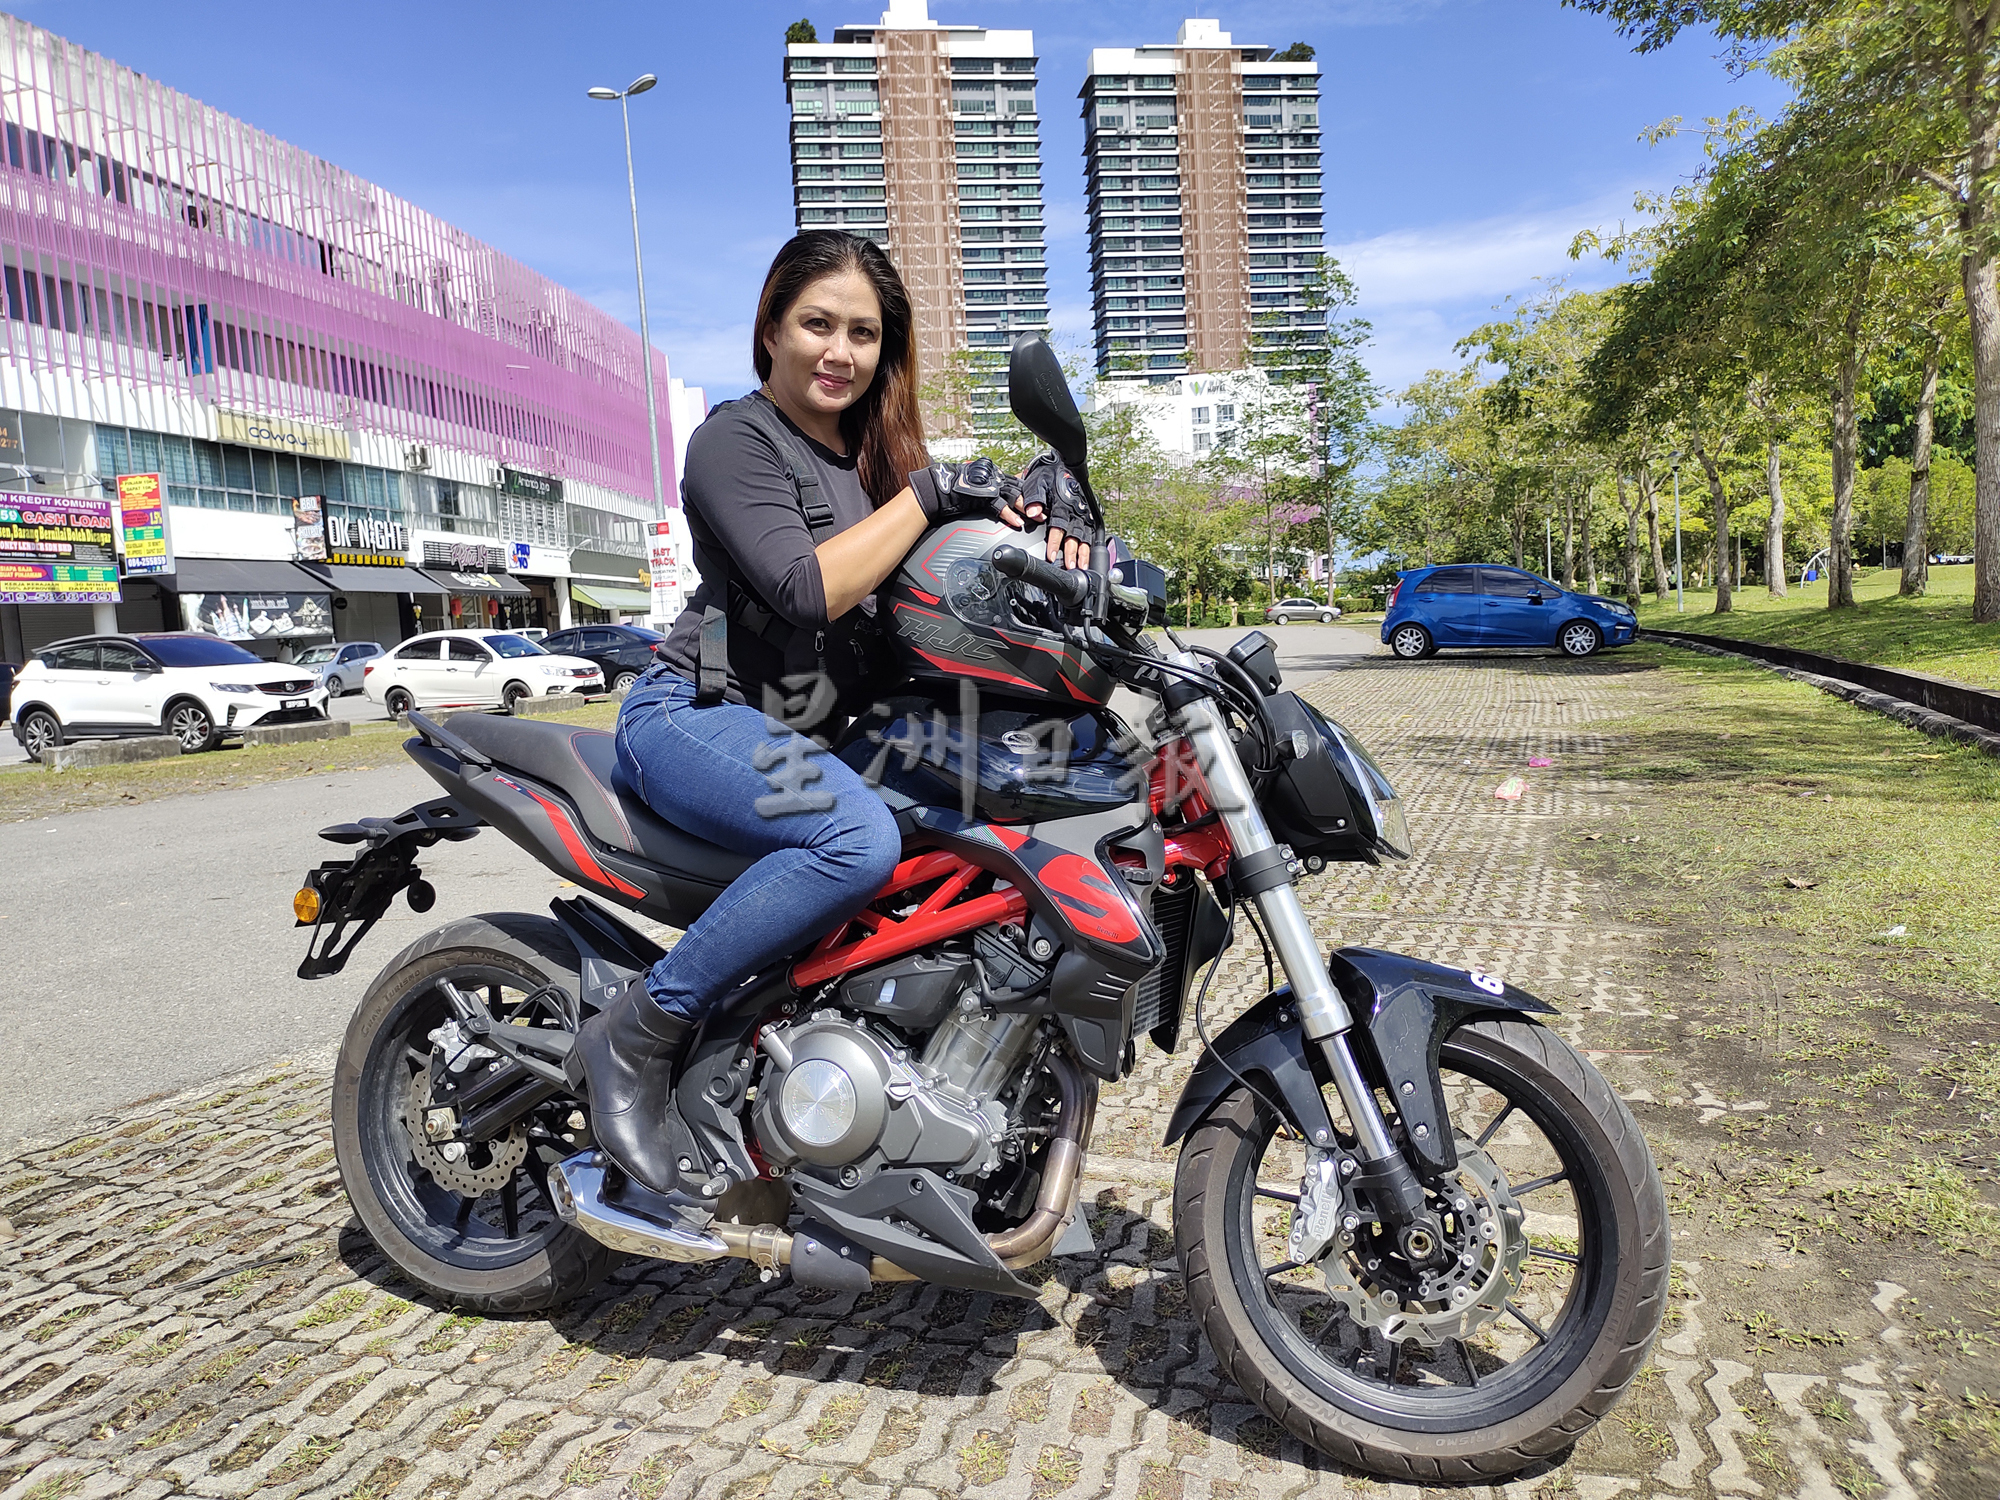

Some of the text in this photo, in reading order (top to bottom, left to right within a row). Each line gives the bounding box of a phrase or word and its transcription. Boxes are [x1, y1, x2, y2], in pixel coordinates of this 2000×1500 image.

[10, 494, 54, 506] KREDIT
[55, 498, 107, 510] KOMUNITI
[23, 511, 67, 526] CASH
[70, 514, 112, 529] LOAN
[327, 515, 352, 548] OK
[652, 548, 671, 558] FAST
[651, 557, 676, 567] TRACK
[896, 614, 1011, 660] HJC
[1096, 925, 1120, 939] Benelli
[381, 969, 421, 1003] TURISMO
